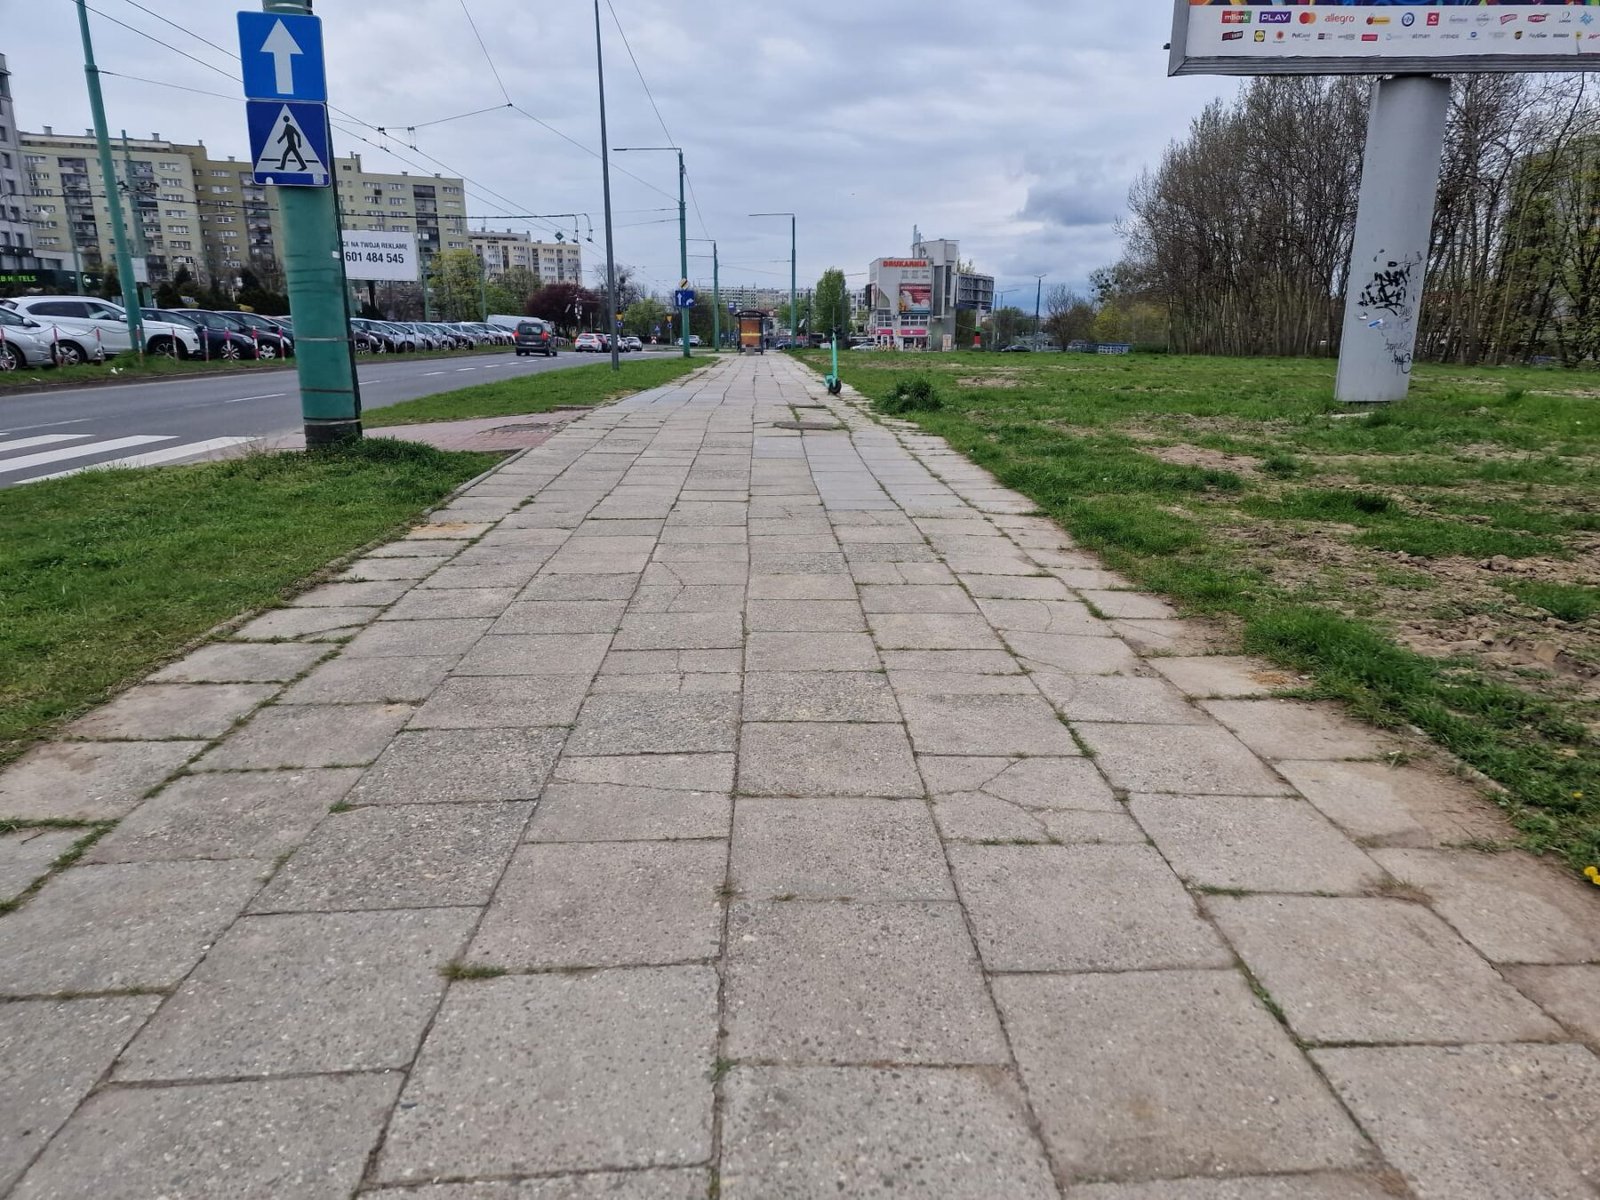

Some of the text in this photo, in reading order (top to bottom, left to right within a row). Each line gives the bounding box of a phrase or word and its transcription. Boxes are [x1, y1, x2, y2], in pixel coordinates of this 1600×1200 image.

[1261, 13, 1289, 21] PLAY
[1324, 13, 1355, 24] allegro
[345, 251, 404, 264] 601 484 545
[883, 260, 927, 268] DRUKARNIA
